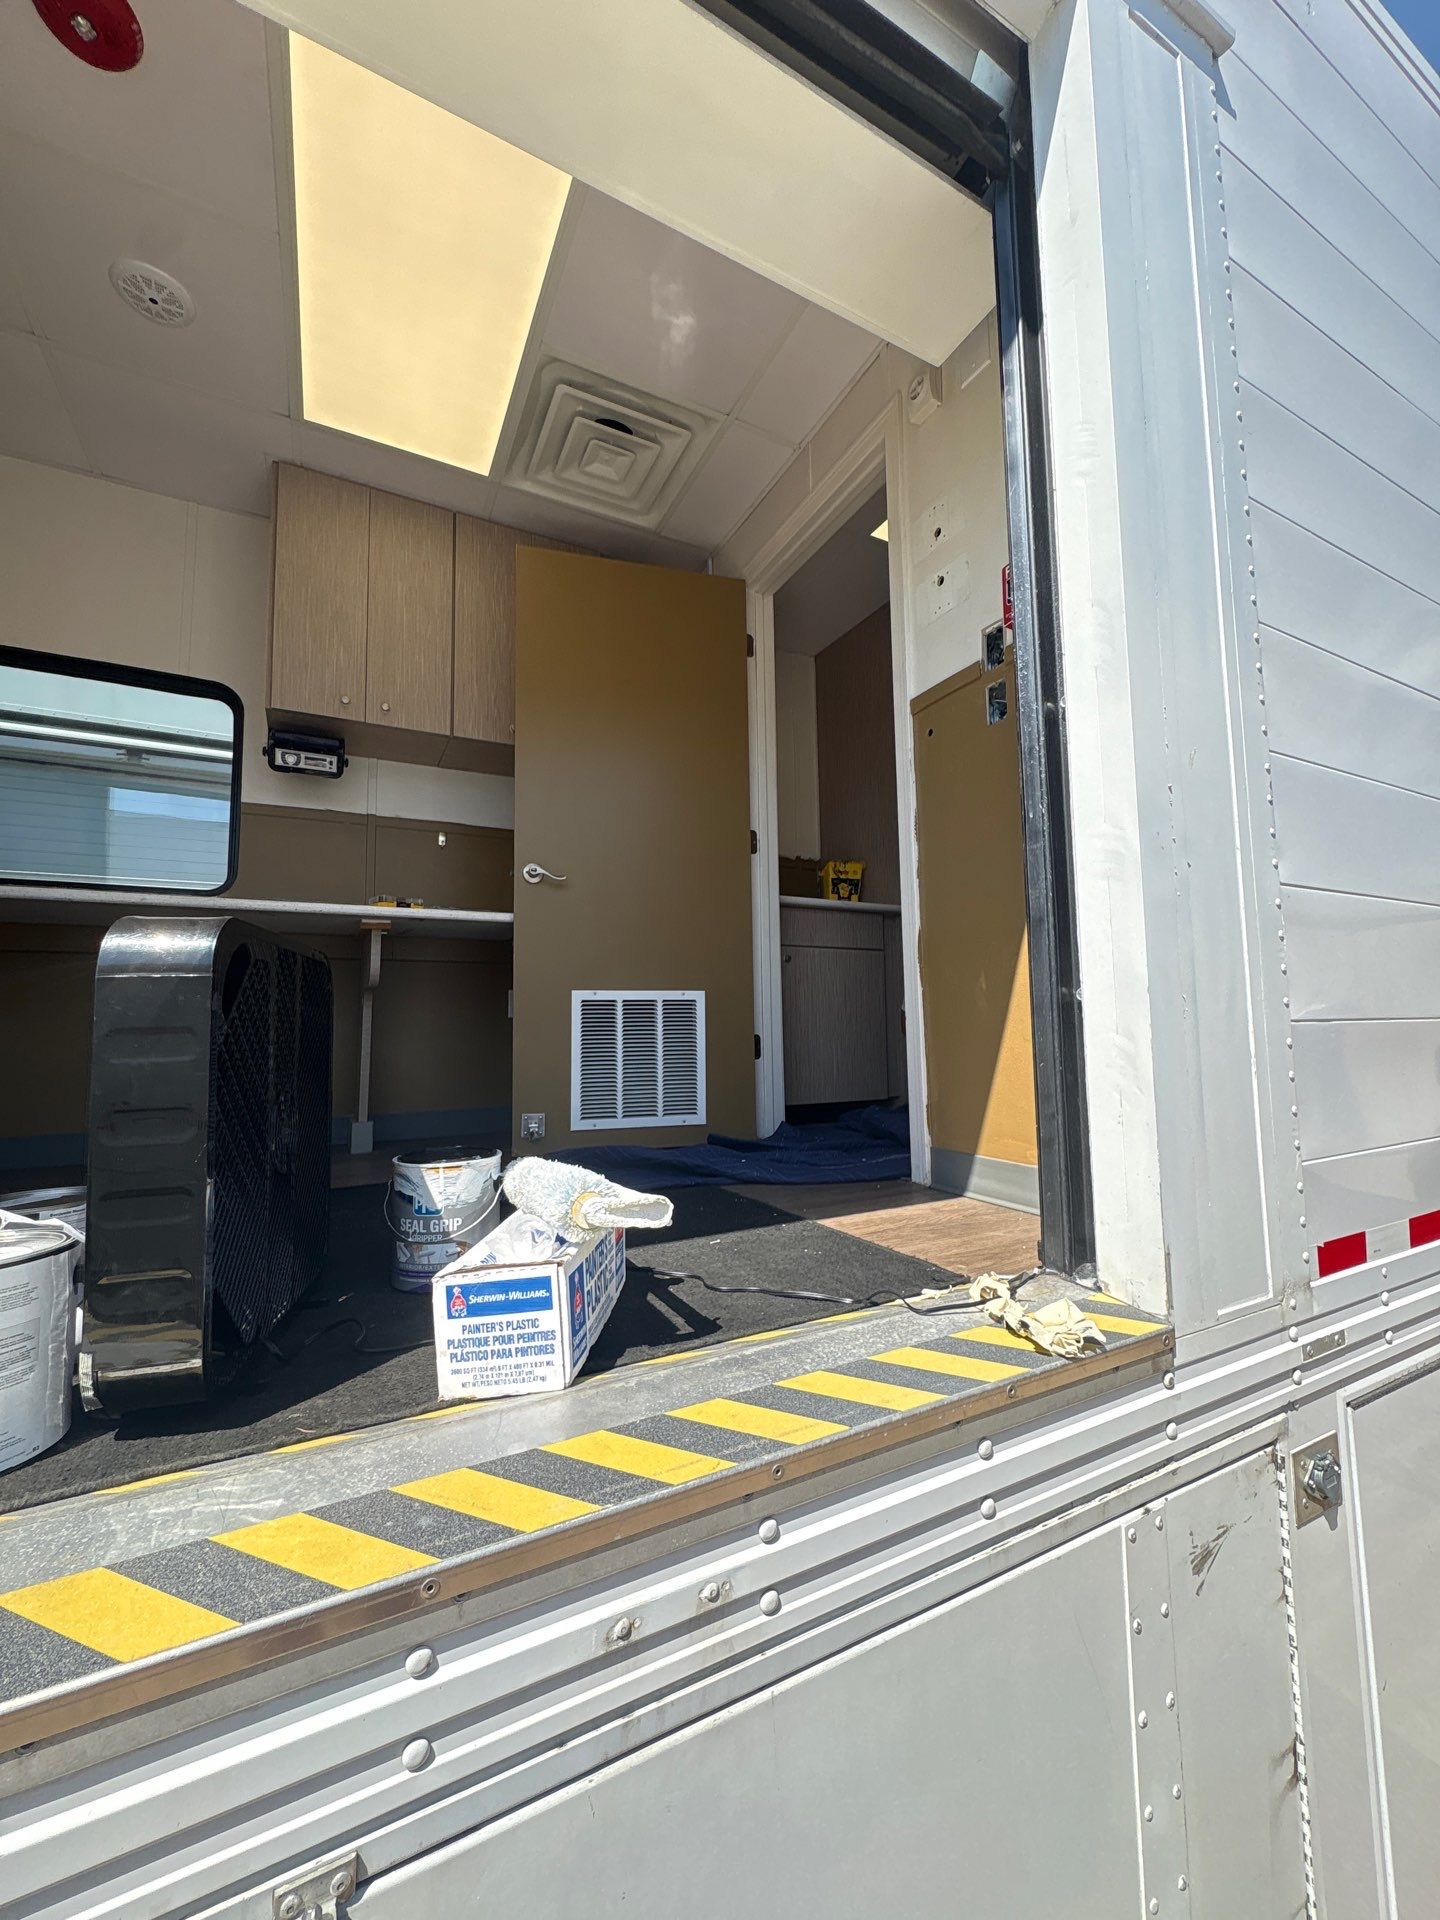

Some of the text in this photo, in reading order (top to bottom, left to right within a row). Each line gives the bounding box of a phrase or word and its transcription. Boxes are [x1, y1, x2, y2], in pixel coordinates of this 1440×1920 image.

[400, 1217, 463, 1233] SEAL GRIP
[462, 1318, 540, 1335] PAINTER'S PLASTIC
[447, 1336, 491, 1350] PLASTIQUE
[493, 1334, 515, 1346] POUR
[517, 1330, 557, 1344] PEINTRES
[450, 1349, 489, 1363] PLÁSTICO
[491, 1347, 514, 1359] PARA
[515, 1344, 556, 1358] PINTORES
